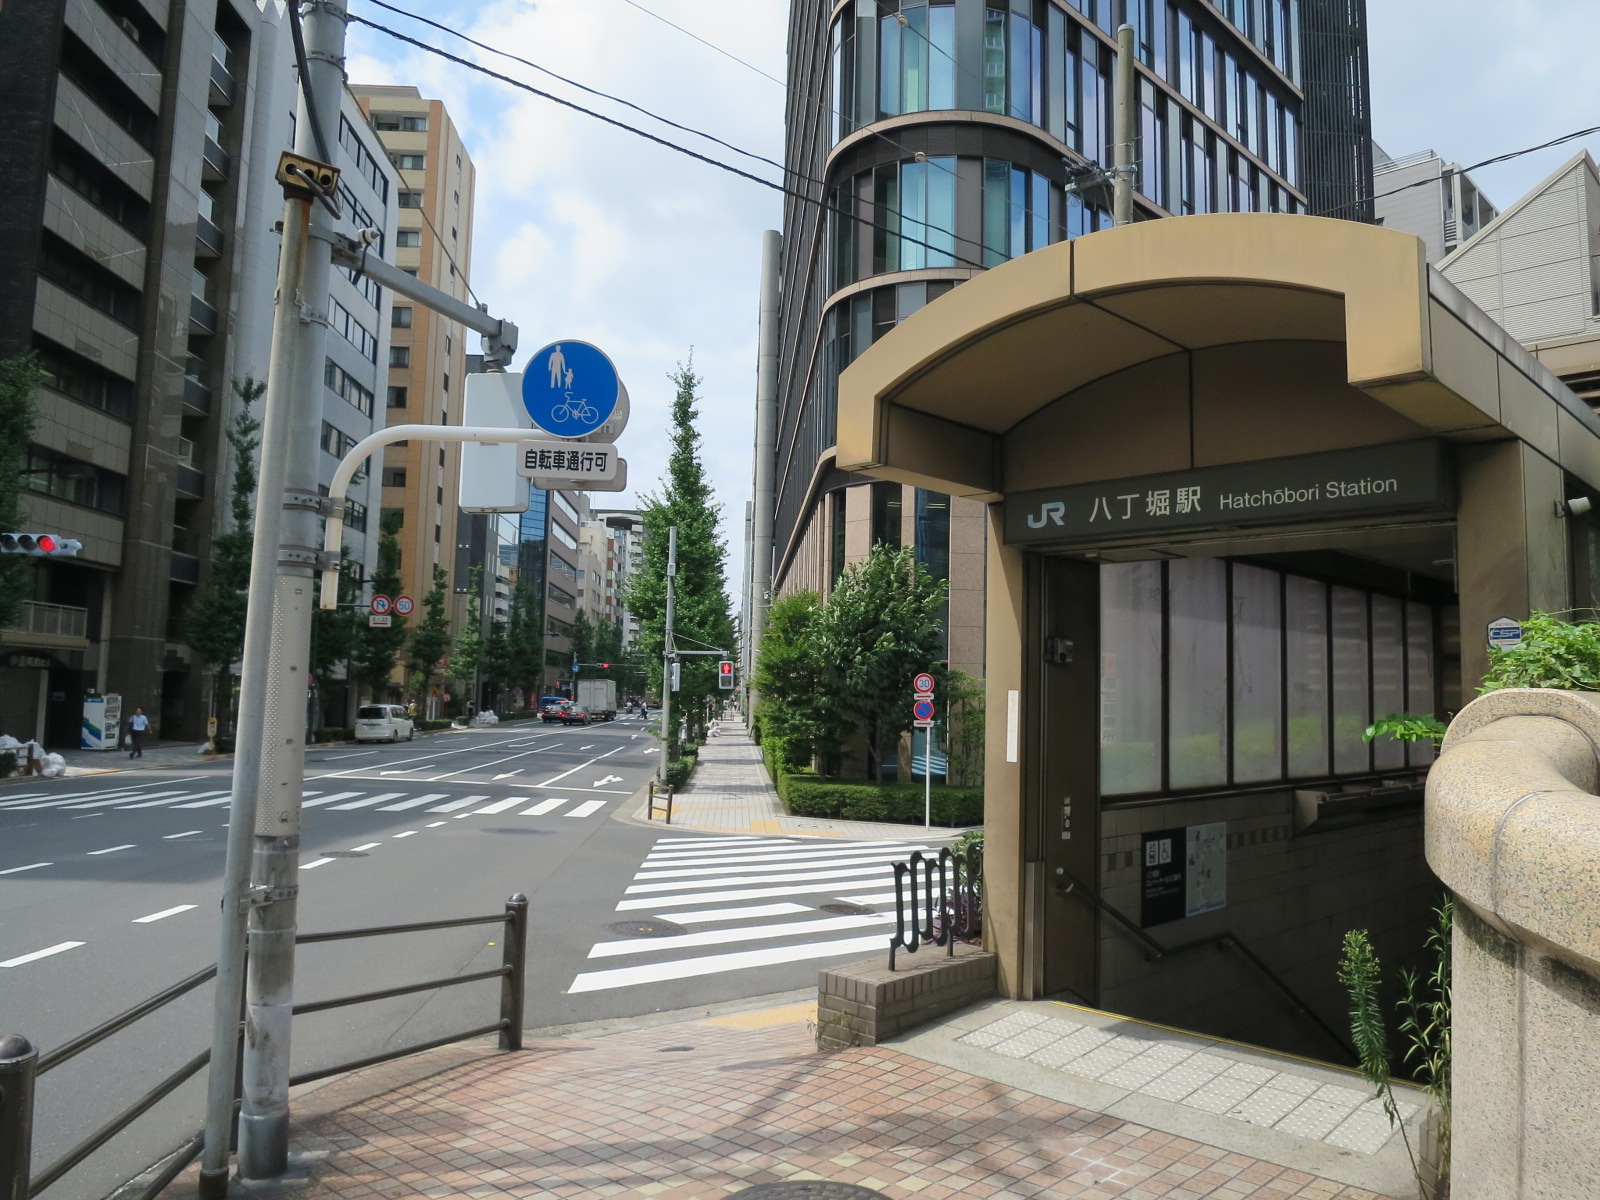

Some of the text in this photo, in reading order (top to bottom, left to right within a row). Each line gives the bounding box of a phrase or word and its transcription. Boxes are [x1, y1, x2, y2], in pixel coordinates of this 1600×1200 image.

[525, 449, 608, 472] 自転車通行可
[1089, 486, 1202, 523] 八丁堀駅
[1219, 477, 1397, 510] Hatchōbori Station
[1027, 502, 1066, 529] JR
[399, 601, 410, 610] 50
[1490, 629, 1519, 637] CSP
[919, 679, 929, 688] 30
